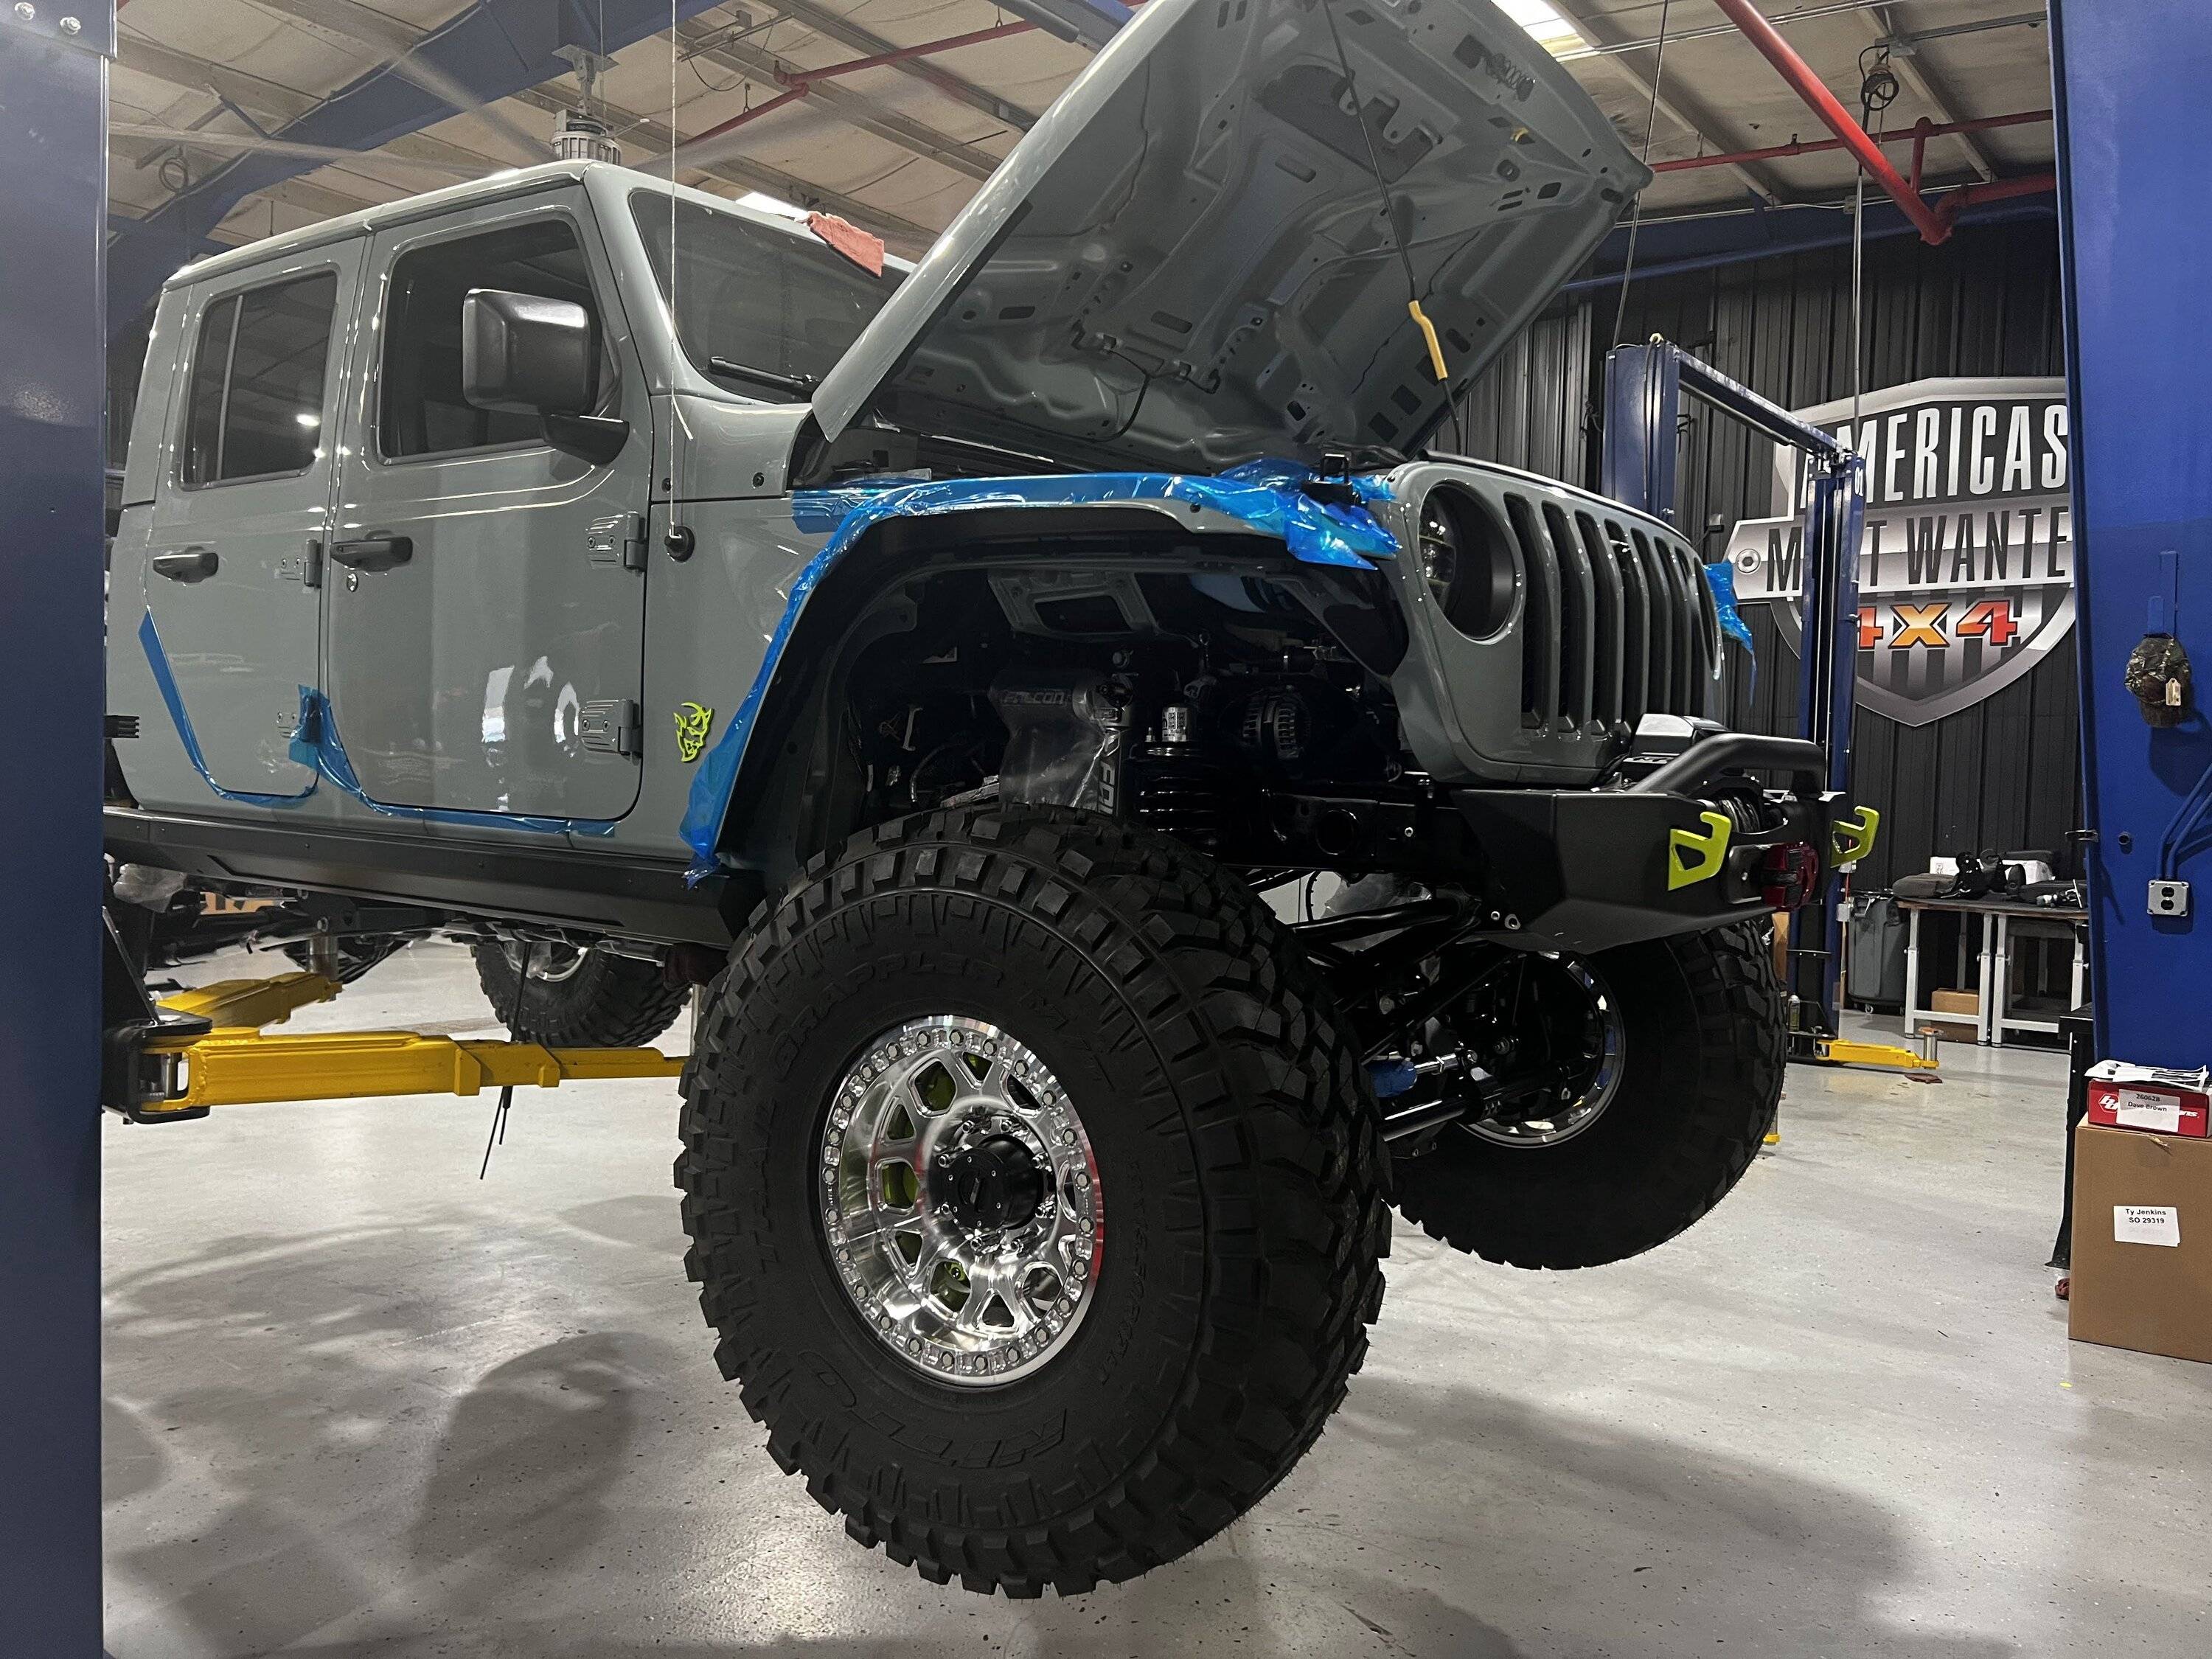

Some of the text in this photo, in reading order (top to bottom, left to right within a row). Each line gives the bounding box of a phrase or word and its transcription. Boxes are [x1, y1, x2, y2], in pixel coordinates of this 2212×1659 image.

[1854, 466, 1864, 497] 01
[1907, 506, 2070, 585] WANTE
[2146, 1104, 2167, 1112] Brown
